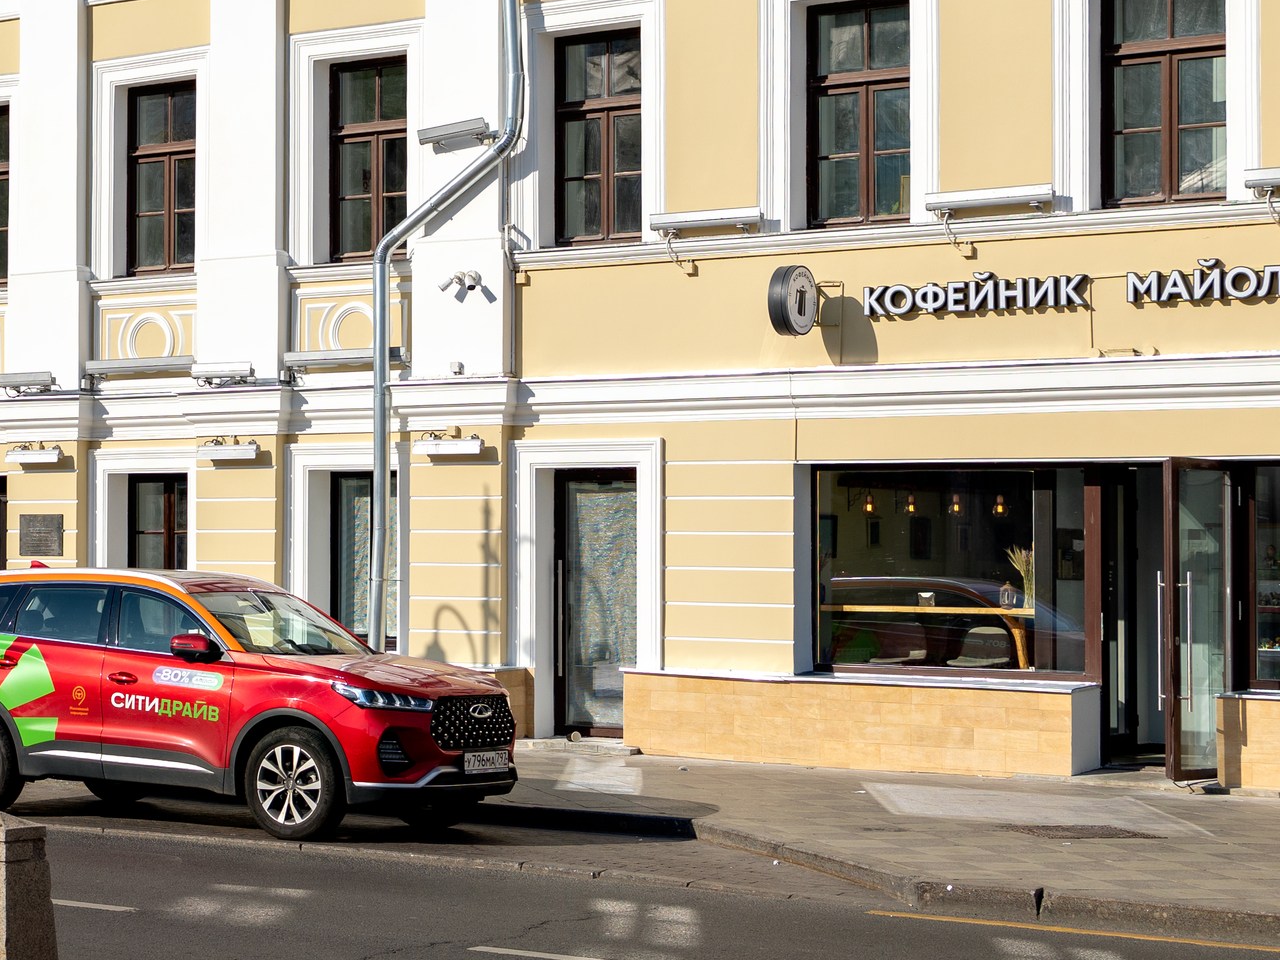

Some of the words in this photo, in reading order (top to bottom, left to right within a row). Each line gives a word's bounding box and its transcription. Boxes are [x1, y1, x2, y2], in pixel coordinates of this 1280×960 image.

[863, 272, 1089, 316] КОФЕЙНИК
[156, 669, 190, 683] -80%
[111, 692, 220, 722] СИТИДРАЙВ
